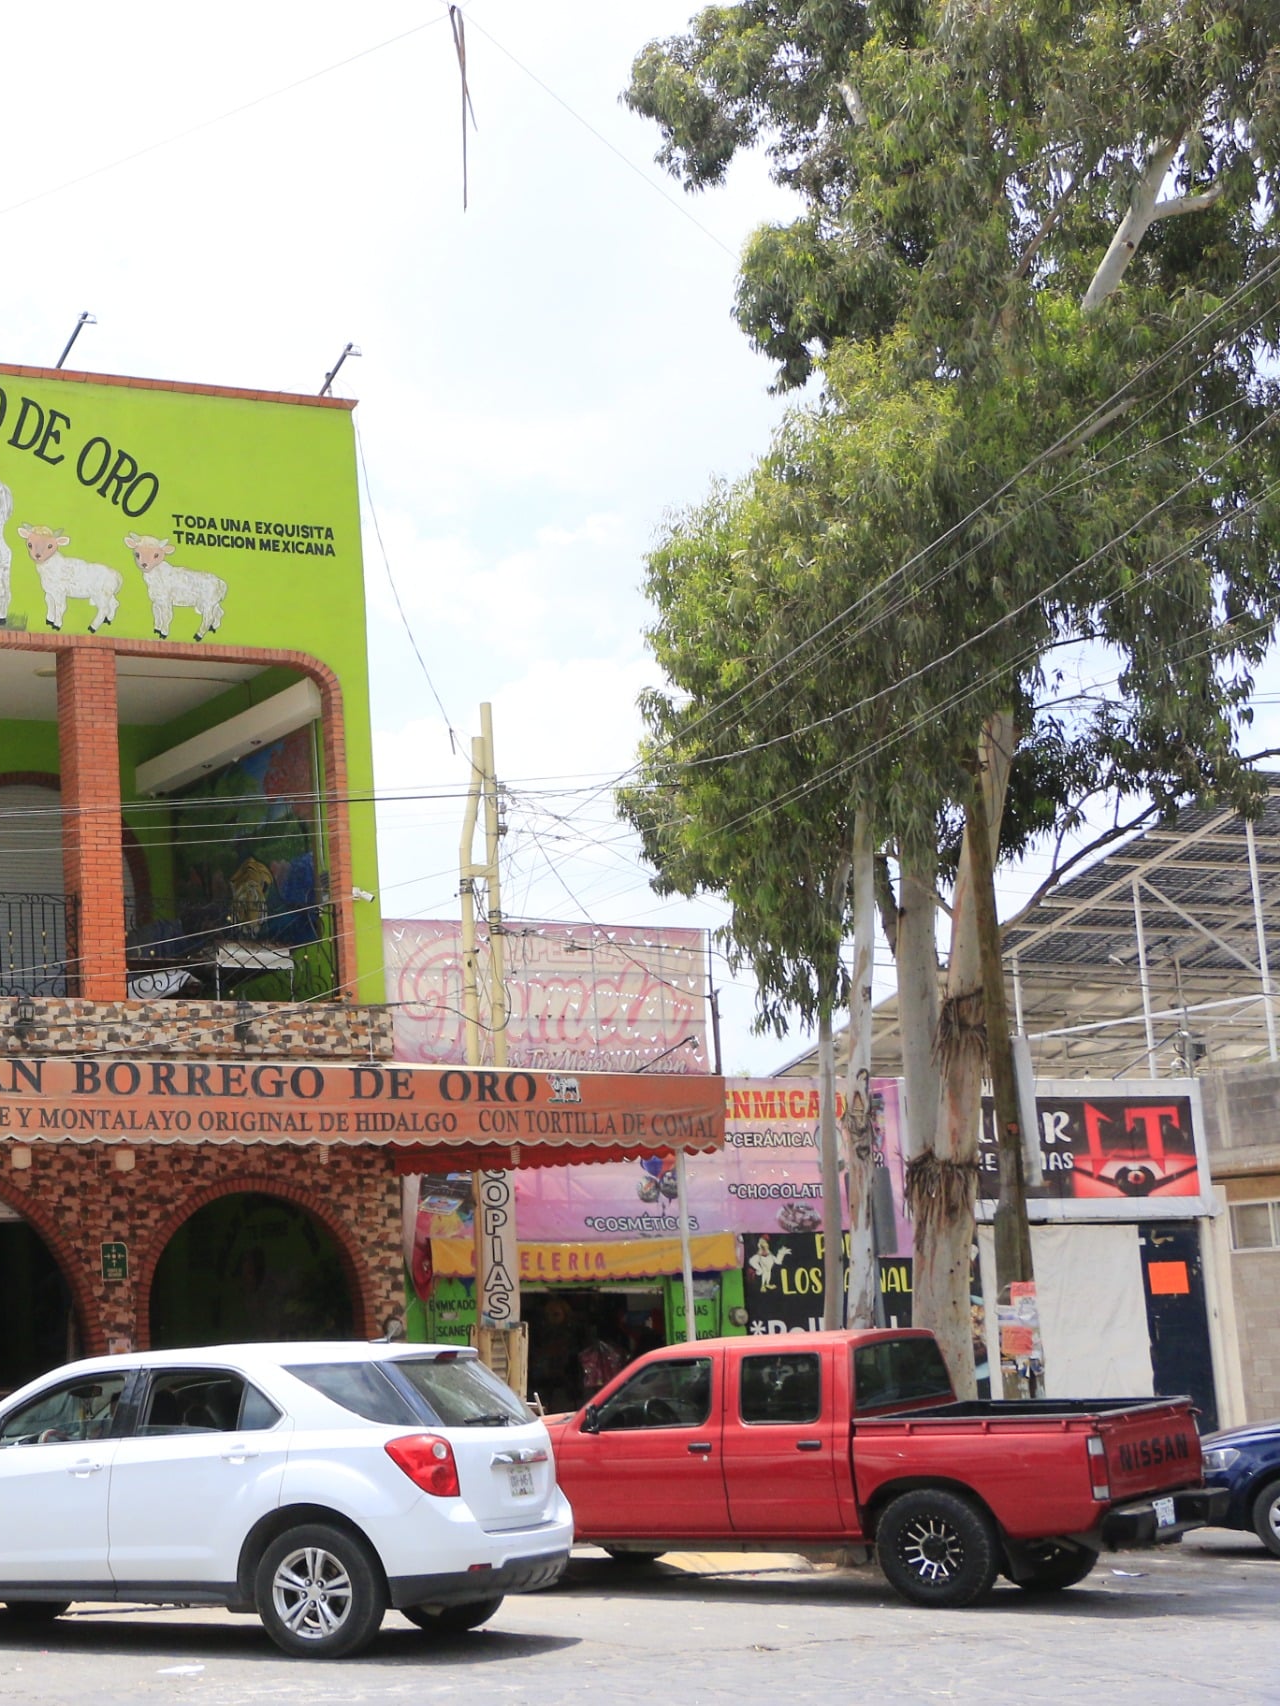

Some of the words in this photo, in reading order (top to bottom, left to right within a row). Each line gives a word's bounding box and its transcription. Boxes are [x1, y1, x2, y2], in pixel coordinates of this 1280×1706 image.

[7, 397, 71, 466] DE
[76, 437, 160, 518] ORO
[172, 514, 217, 530] TODA
[220, 518, 252, 533] UNA
[255, 521, 335, 541] EXQUISITA
[173, 530, 256, 551] TRADICION
[259, 538, 336, 557] MEXICANA
[71, 1060, 325, 1099] BORREGO
[349, 1067, 415, 1100] DE
[438, 1069, 538, 1102] ORO
[725, 1089, 846, 1120] NMICA
[15, 1106, 32, 1128] Y
[40, 1107, 192, 1131] MONTALAYO
[197, 1110, 313, 1132] ORIGINAL
[320, 1111, 350, 1133] DE
[354, 1112, 458, 1133] HIDALGO
[478, 1109, 519, 1133] CON
[524, 1110, 617, 1136] TORTILLA
[622, 1113, 647, 1136] DE
[650, 1113, 719, 1139] COMAL
[781, 1267, 823, 1295] LOS
[675, 1330, 713, 1342] REALOS
[1120, 1433, 1189, 1472] NISSAN
